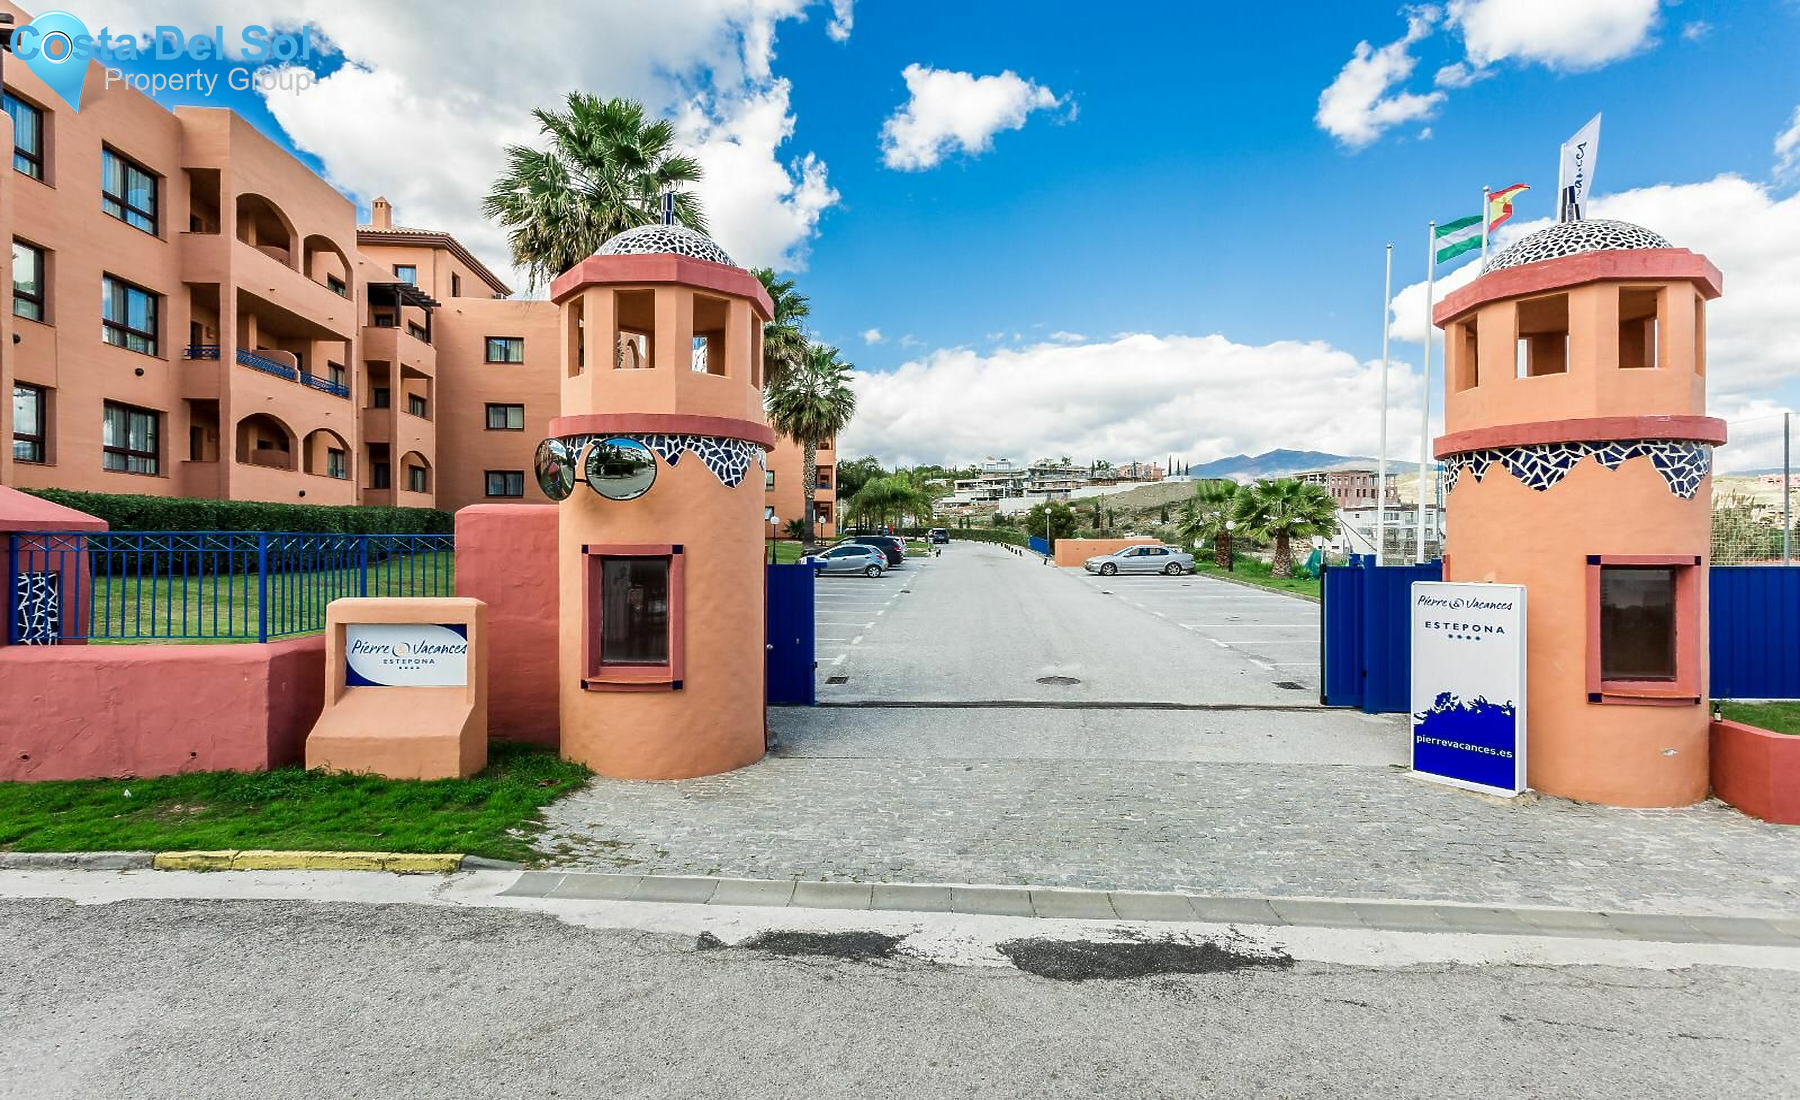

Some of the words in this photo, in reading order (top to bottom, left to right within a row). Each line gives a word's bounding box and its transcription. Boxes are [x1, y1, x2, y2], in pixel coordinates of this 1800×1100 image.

[1417, 595, 1448, 607] Pierre
[1466, 597, 1513, 611] Vacances
[1425, 621, 1506, 634] ESTEPONA
[351, 639, 390, 654] Pierre
[413, 640, 468, 655] Vacances
[1416, 735, 1513, 759] pierrevacances.es
